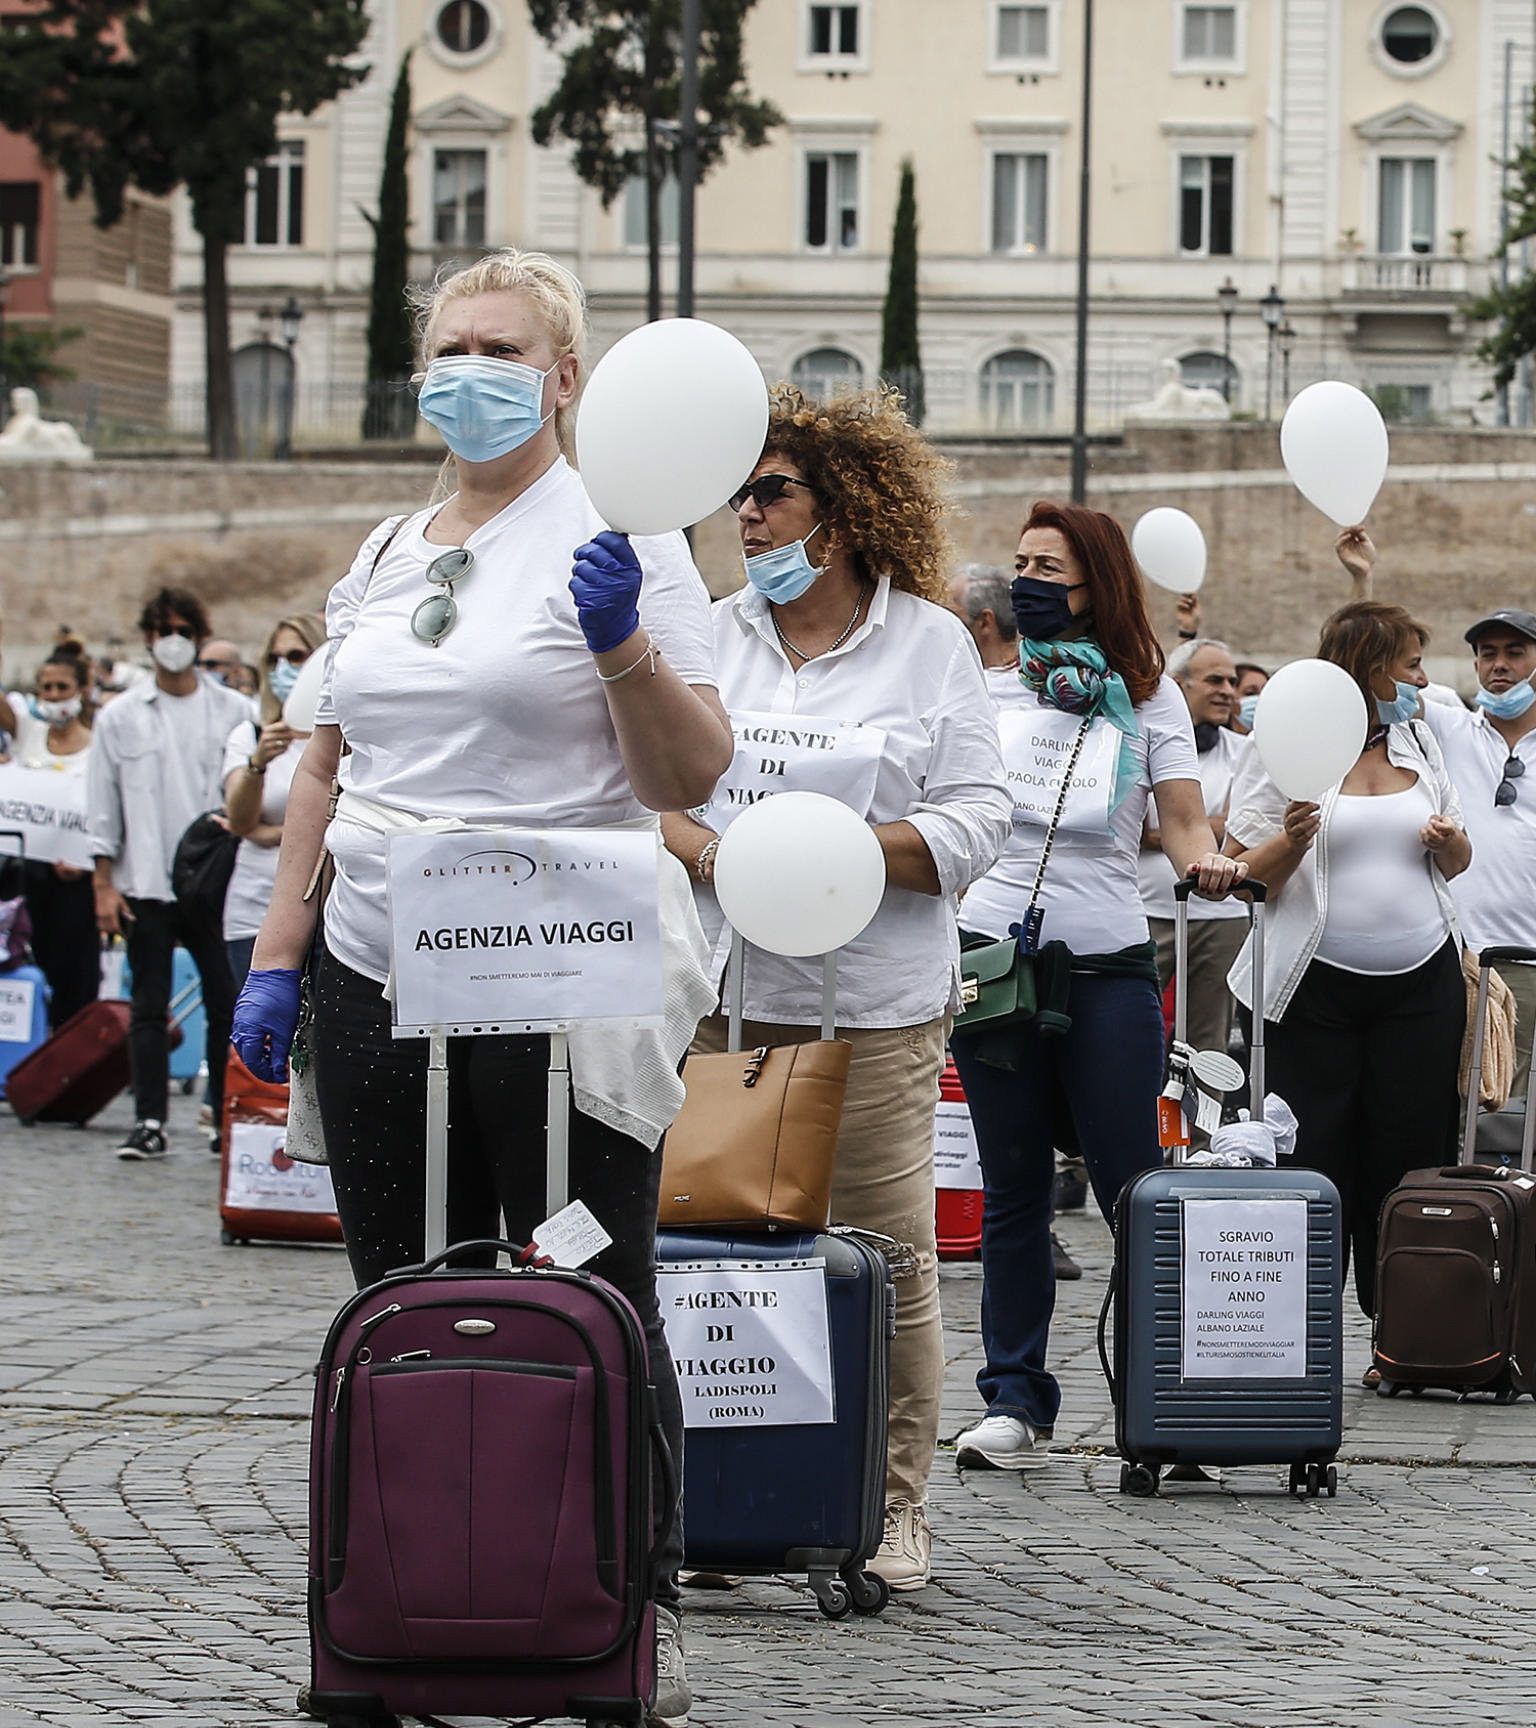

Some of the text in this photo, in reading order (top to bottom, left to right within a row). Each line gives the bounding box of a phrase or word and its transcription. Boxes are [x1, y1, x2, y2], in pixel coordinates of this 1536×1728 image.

[733, 727, 836, 750] AGENTE
[1031, 736, 1074, 752] DARLIN
[759, 758, 787, 776] DI
[1007, 771, 1046, 787] PAOLA
[1037, 806, 1068, 815] LAZILE
[424, 861, 619, 877] GLITTER TRAVEL
[415, 920, 634, 951] AGENZIA VIAGGI
[1219, 1231, 1274, 1243] SGRAVIO
[1198, 1251, 1295, 1262] TOTALE TRIBUTI
[1210, 1271, 1283, 1283] FINO A FINE
[674, 1291, 778, 1310] #AGENTE
[1228, 1291, 1266, 1303] ANNO
[1197, 1311, 1265, 1319] DARLING VIAGGI
[706, 1324, 734, 1342] DI
[1196, 1324, 1265, 1333] ALBANO LAZIALE
[674, 1356, 775, 1376] VIAGGIO
[695, 1384, 777, 1397] LADISPOLI
[708, 1406, 765, 1418] (ROMA)
